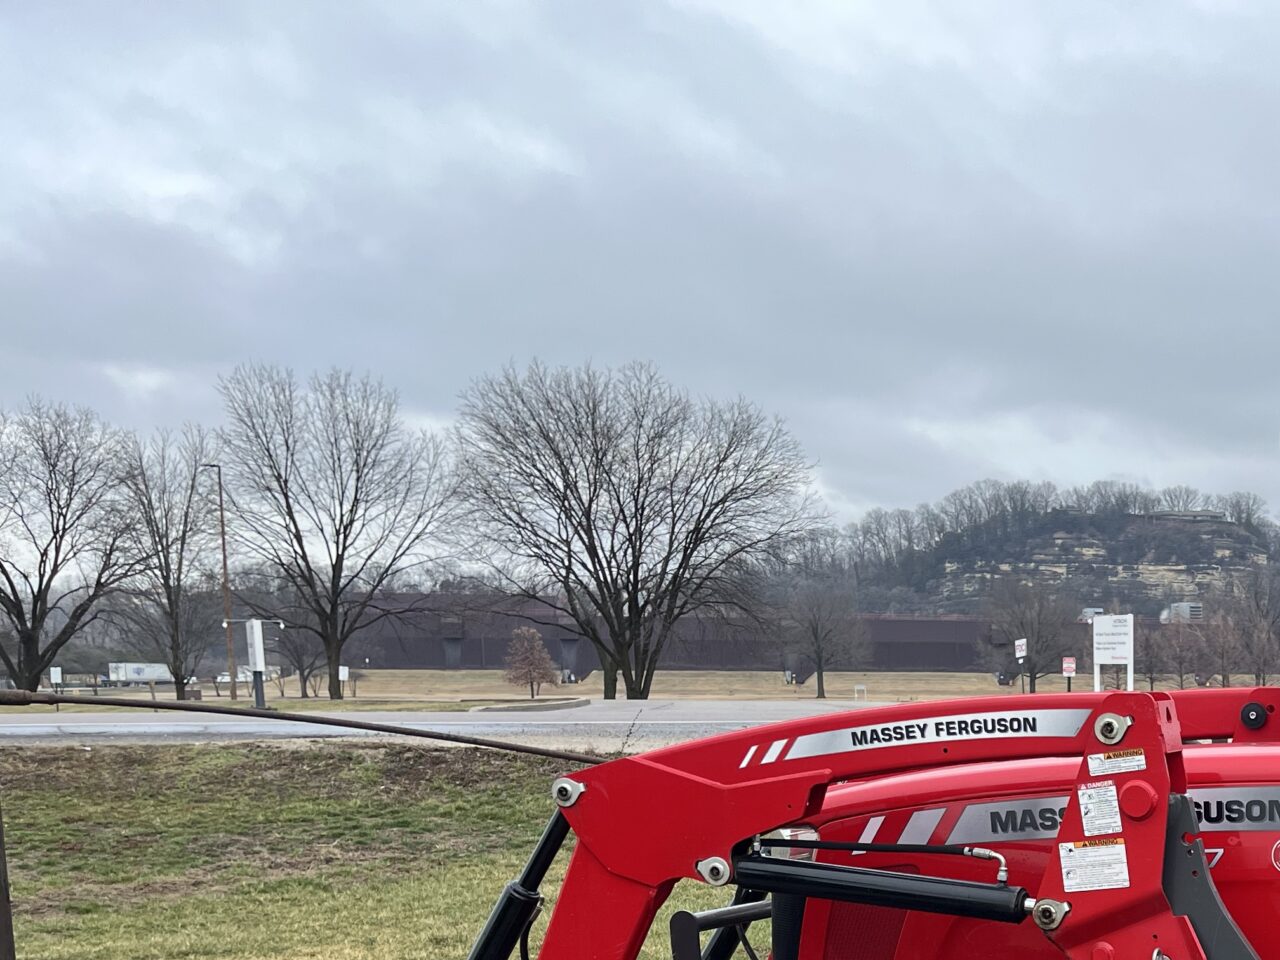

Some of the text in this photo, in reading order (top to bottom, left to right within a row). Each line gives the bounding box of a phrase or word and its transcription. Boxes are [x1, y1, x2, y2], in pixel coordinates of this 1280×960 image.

[851, 717, 1037, 747] MASSEY FERGUSON
[1113, 749, 1143, 759] WARNING
[1086, 780, 1113, 790] DANGER
[990, 807, 1067, 834] MAS
[1088, 839, 1118, 847] WARNING
